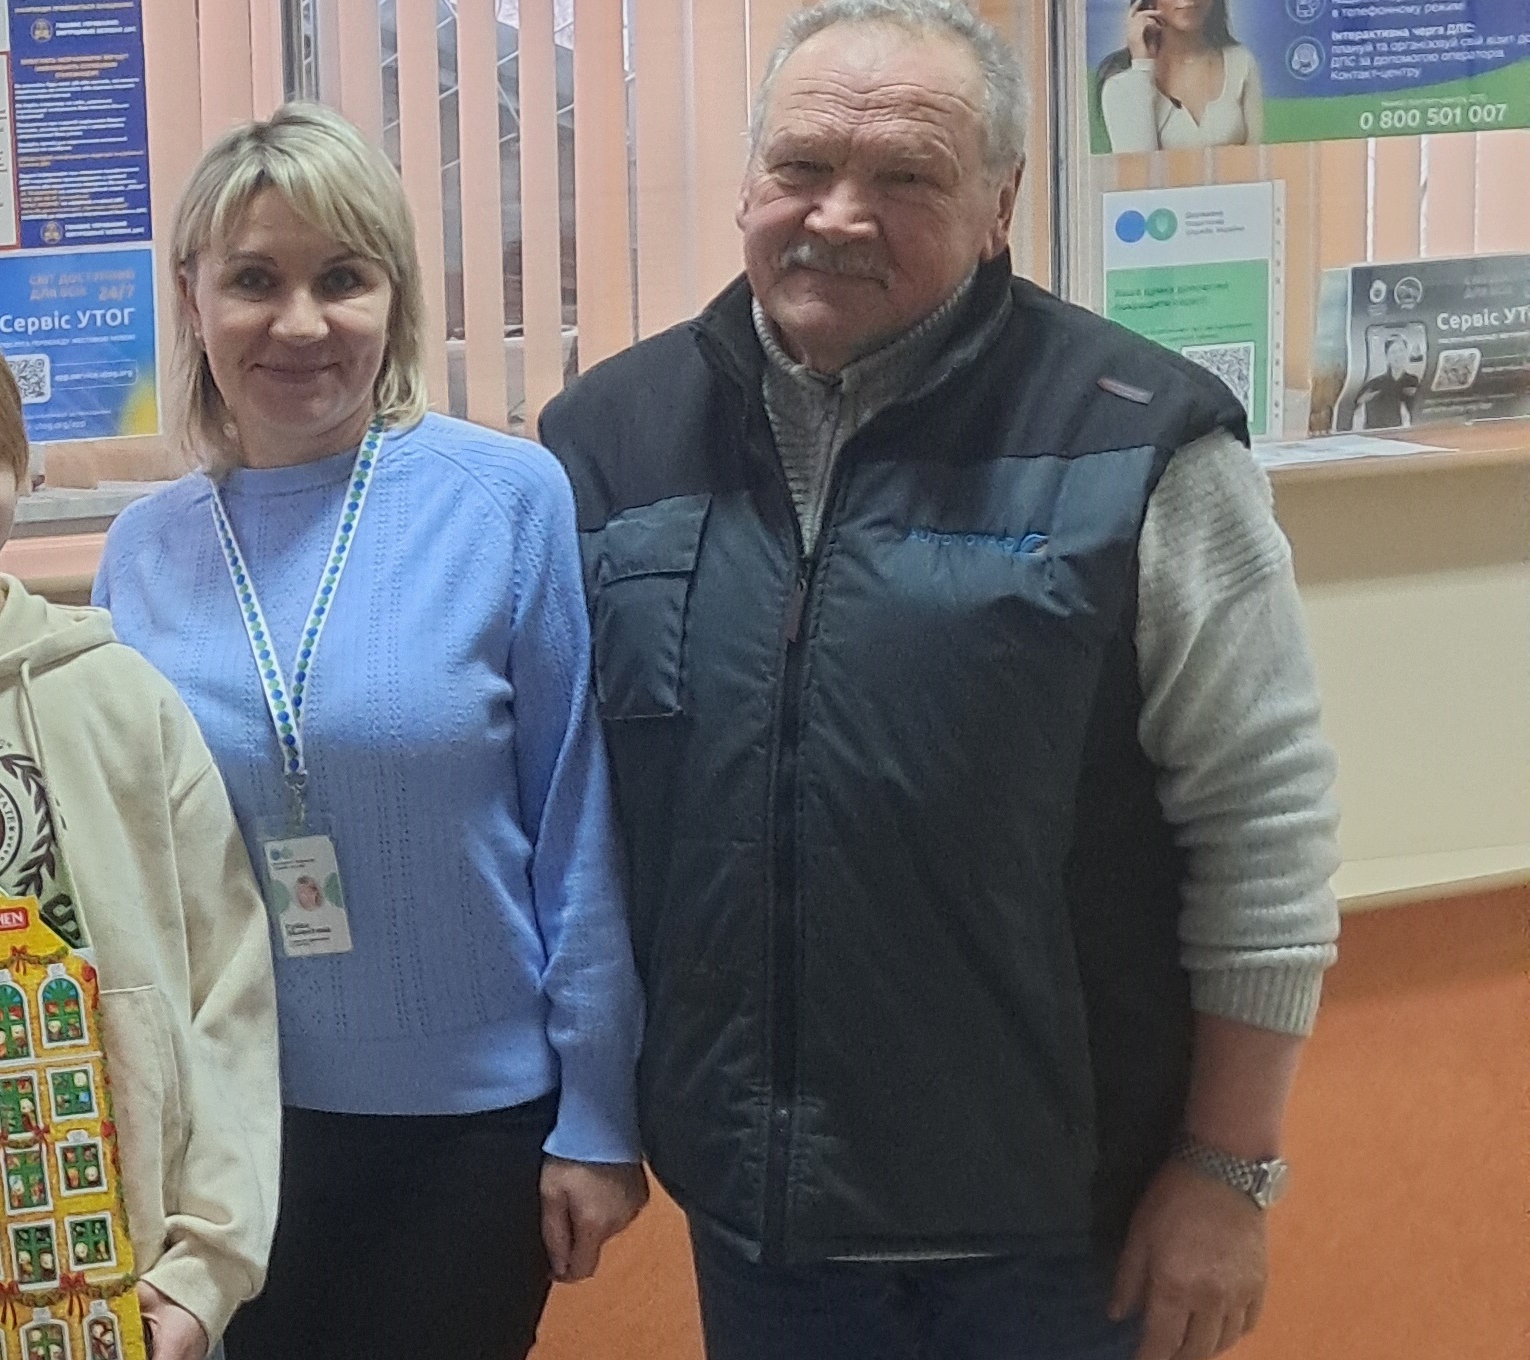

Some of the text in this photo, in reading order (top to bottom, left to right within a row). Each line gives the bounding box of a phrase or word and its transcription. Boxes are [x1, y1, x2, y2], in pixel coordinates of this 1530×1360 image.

[1359, 103, 1507, 130] 0 800 501 007
[76, 307, 136, 329] УТОГ
[1436, 304, 1530, 332] Сервіс УТ
